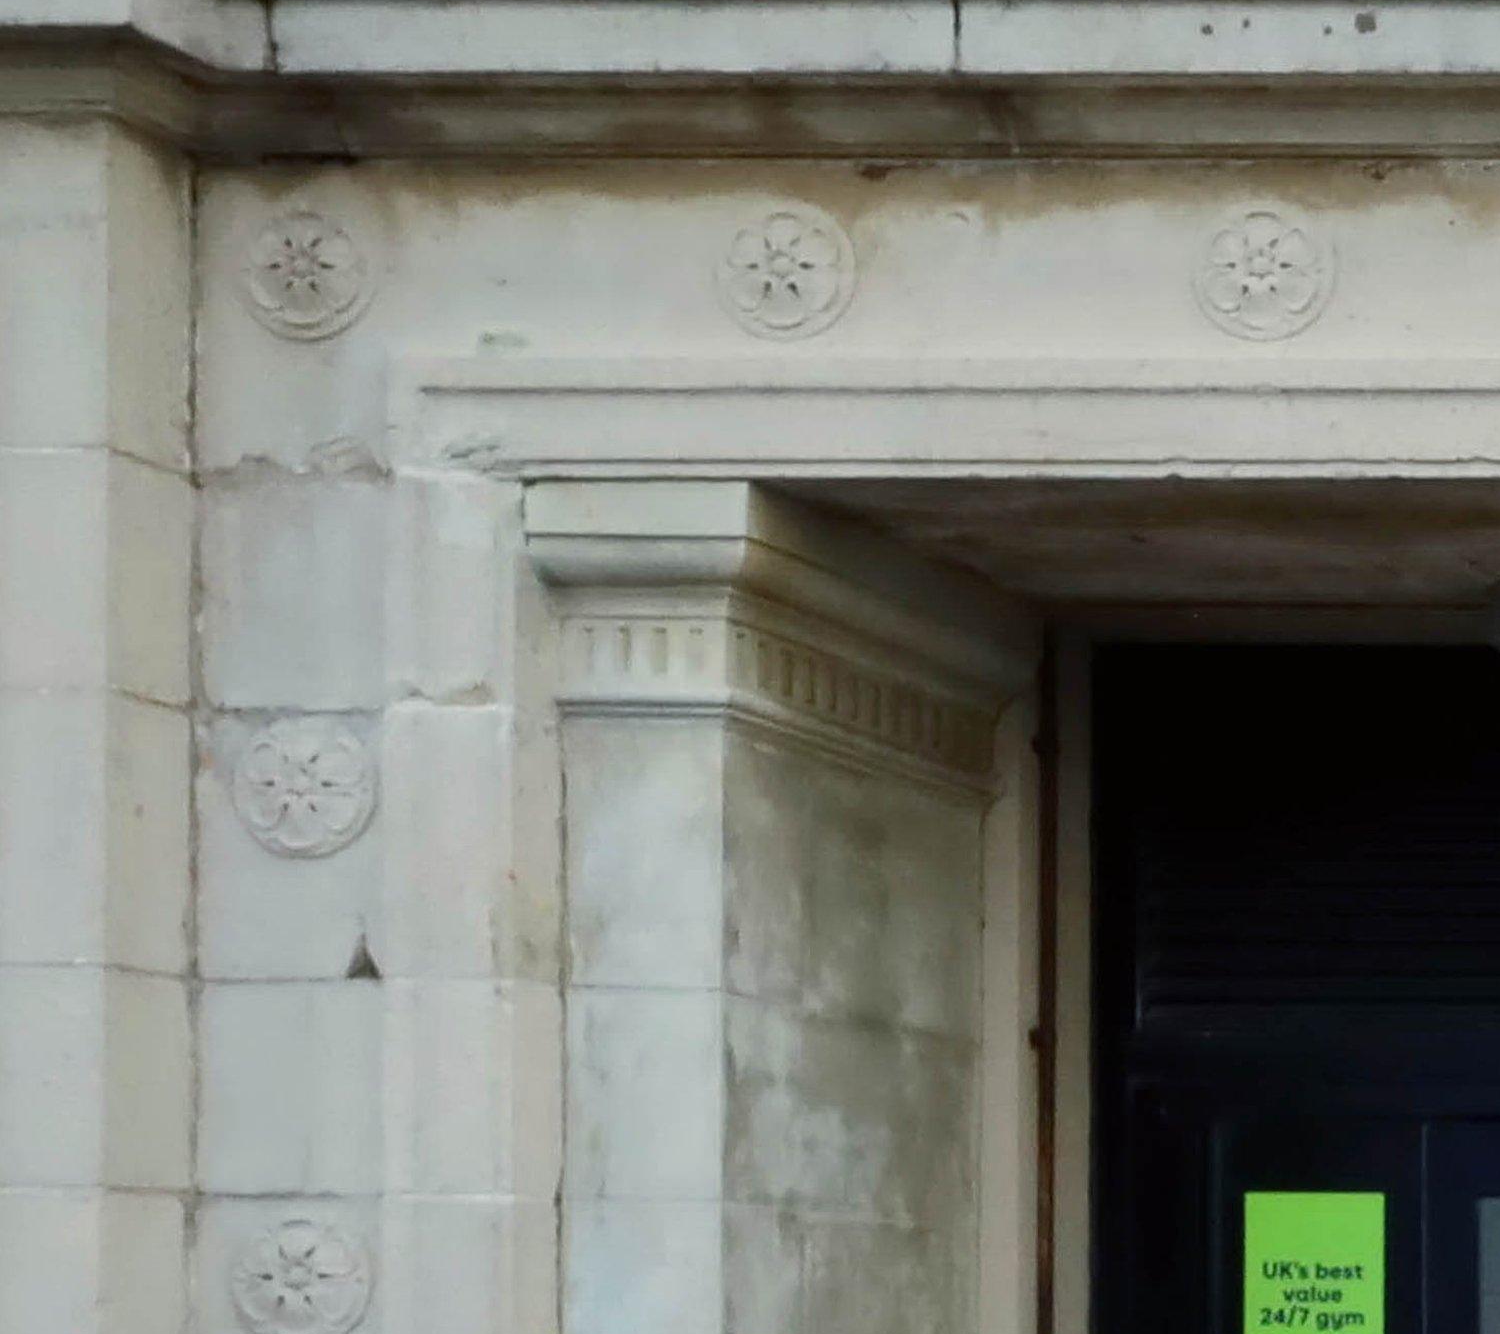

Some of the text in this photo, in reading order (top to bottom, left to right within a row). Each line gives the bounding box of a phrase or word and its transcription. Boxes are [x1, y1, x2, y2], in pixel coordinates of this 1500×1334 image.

[1261, 1261, 1363, 1280] UK's best
[1283, 1283, 1342, 1304] value
[1259, 1306, 1365, 1331] 24/7 gym
